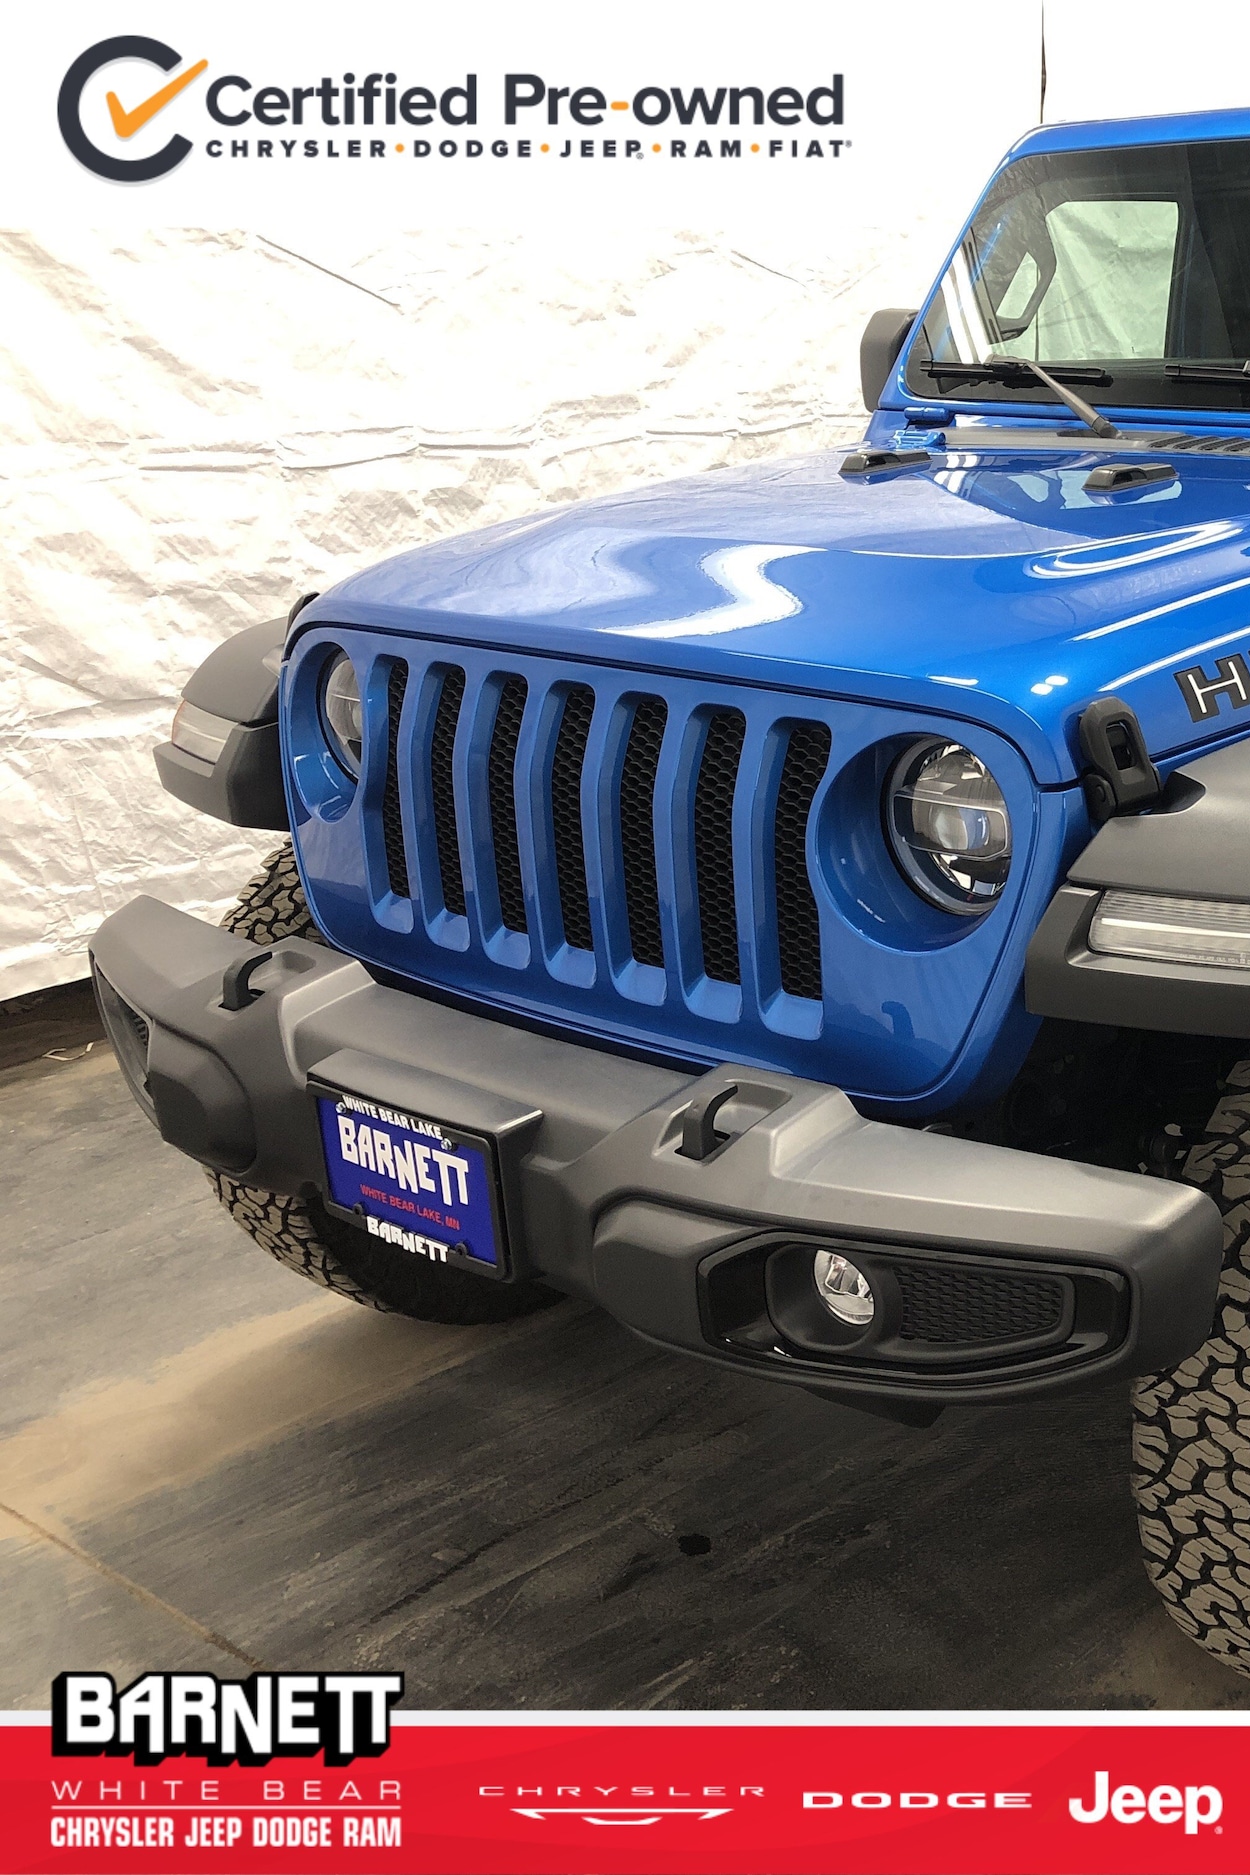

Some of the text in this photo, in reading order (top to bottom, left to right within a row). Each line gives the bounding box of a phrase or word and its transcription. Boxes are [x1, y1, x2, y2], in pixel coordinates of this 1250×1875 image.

[342, 1095, 443, 1140] WHITE BEAR LAKE
[337, 1115, 469, 1206] BARNETT
[360, 1183, 461, 1231] WHITE BEAR LAKE, MN
[366, 1215, 449, 1263] BARNETT
